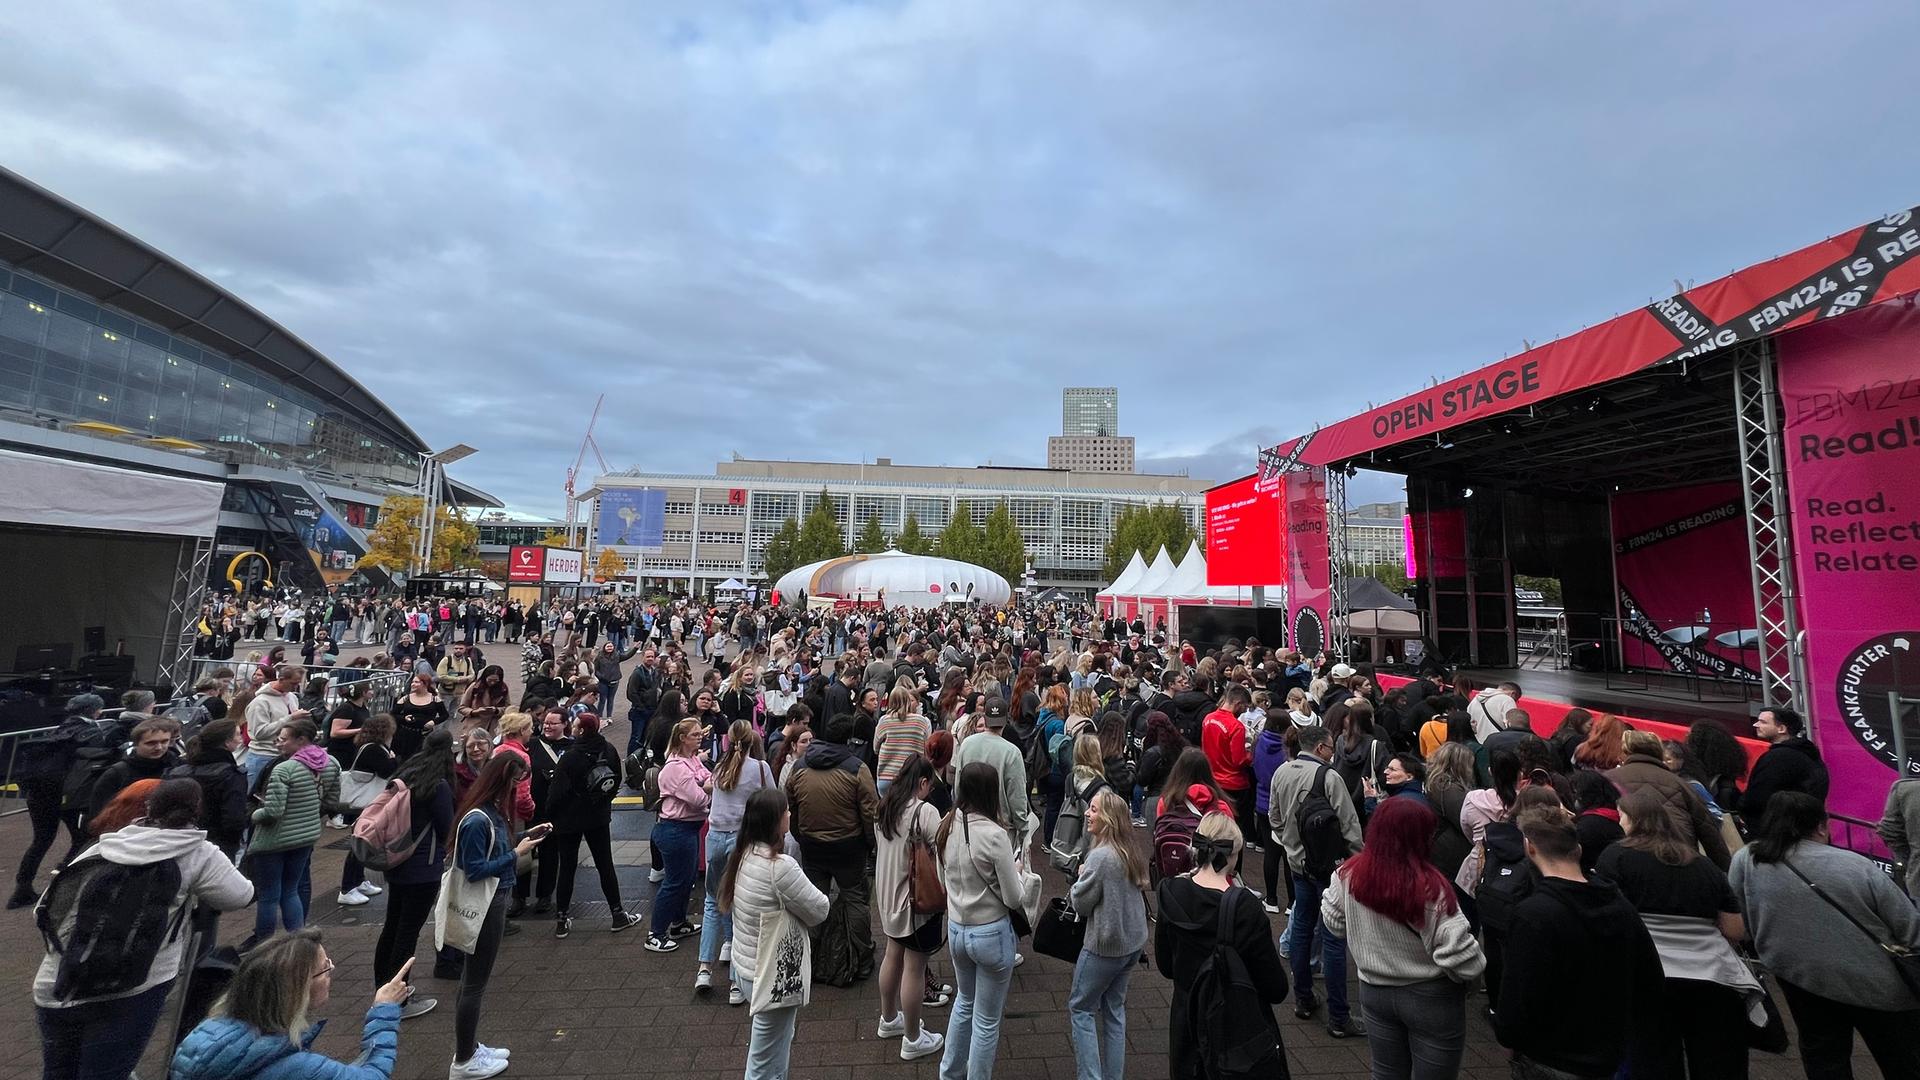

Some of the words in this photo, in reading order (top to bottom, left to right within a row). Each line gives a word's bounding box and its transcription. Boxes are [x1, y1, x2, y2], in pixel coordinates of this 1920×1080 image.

[1748, 277, 1839, 332] FBM24
[1841, 257, 1874, 282] IS
[1372, 399, 1434, 439] OPEN
[1441, 361, 1540, 417] STAGE
[733, 490, 742, 503] 4
[1807, 491, 1896, 518] Read.
[1629, 530, 1663, 550] FBM24
[1665, 525, 1677, 536] IS
[549, 557, 579, 573] HERDER
[1814, 551, 1918, 573] Relate
[1844, 644, 1890, 751] FRANKFURTER
